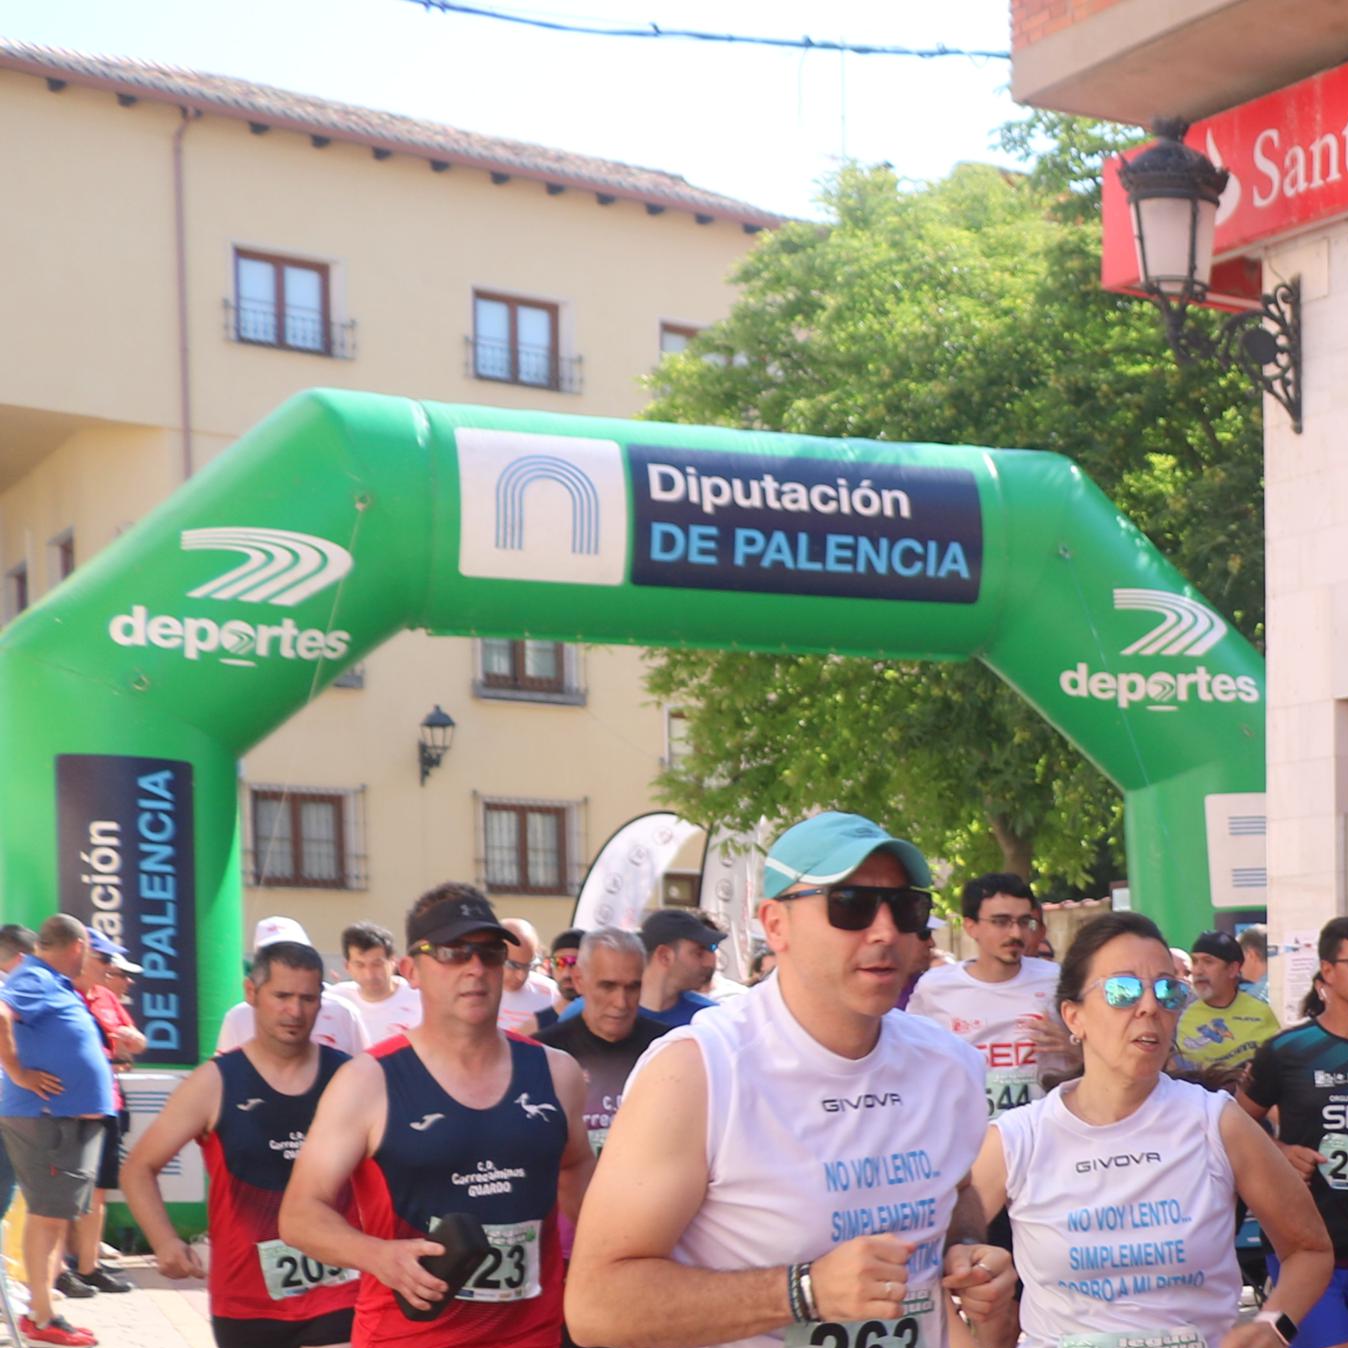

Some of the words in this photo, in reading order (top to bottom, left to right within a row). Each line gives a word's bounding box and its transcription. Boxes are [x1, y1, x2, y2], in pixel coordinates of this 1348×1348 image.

[647, 461, 911, 518] Diputación
[649, 523, 718, 564] DE
[734, 528, 971, 579] PALENCIA
[109, 604, 351, 664] deportes
[1059, 662, 1260, 709] deportes
[136, 768, 178, 980] PALENCIA
[141, 992, 179, 1050] DE
[822, 1093, 902, 1112] GIVOVA
[825, 1160, 850, 1192] NO
[851, 1156, 882, 1189] VOY
[1075, 1152, 1161, 1174] GIVOVA
[1068, 1208, 1091, 1232] NO
[1096, 1205, 1126, 1231] VOY
[277, 1255, 342, 1289] 20
[467, 1244, 525, 1289] 23
[1069, 1238, 1186, 1271] SIMPLEMENTE
[1118, 1276, 1129, 1297] A
[1133, 1275, 1152, 1294] MI
